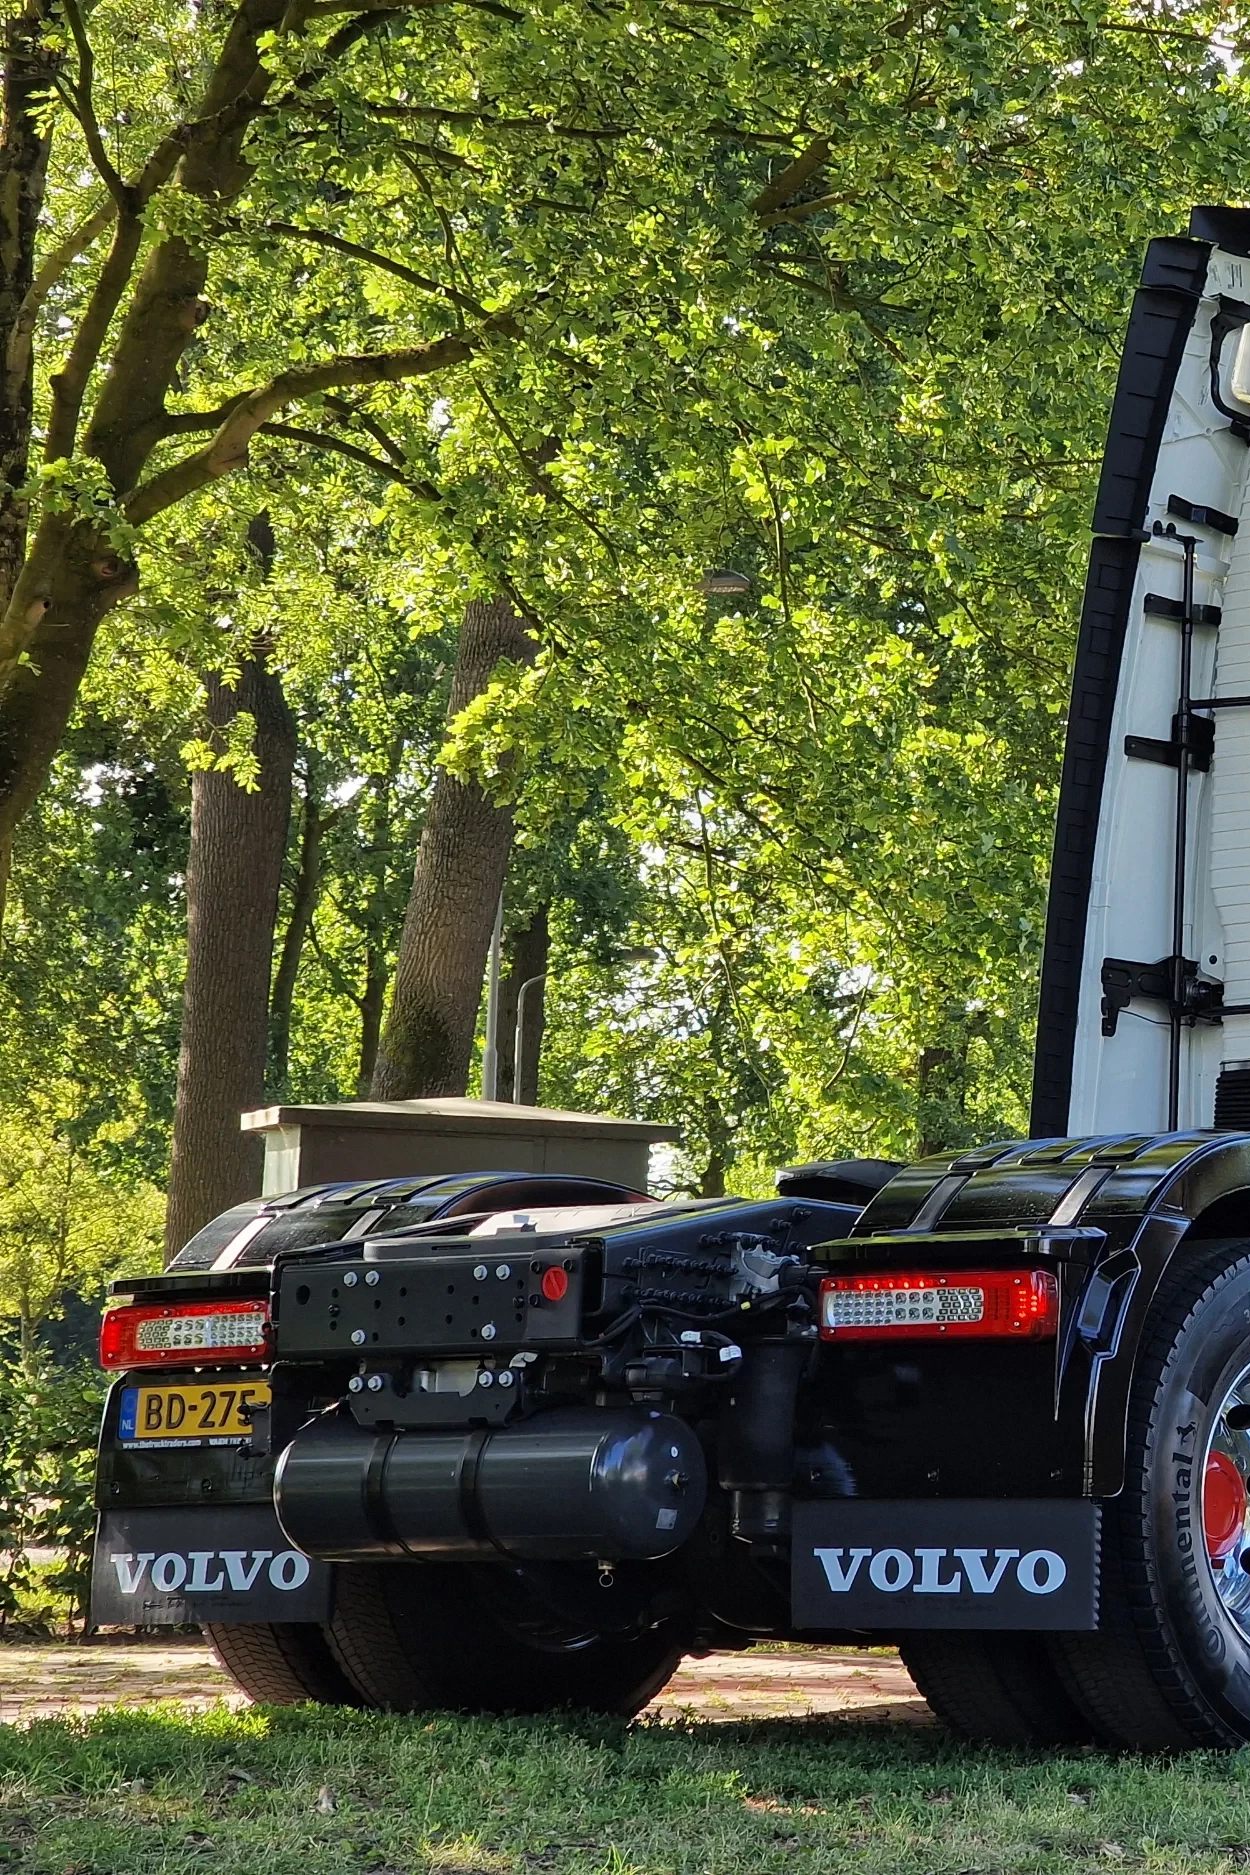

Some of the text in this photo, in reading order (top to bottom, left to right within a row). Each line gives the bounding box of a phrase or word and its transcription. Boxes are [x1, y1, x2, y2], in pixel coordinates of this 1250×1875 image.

[121, 1419, 134, 1430] NL
[110, 1550, 310, 1594] VOLVO
[814, 1548, 1067, 1594] VOLVO
